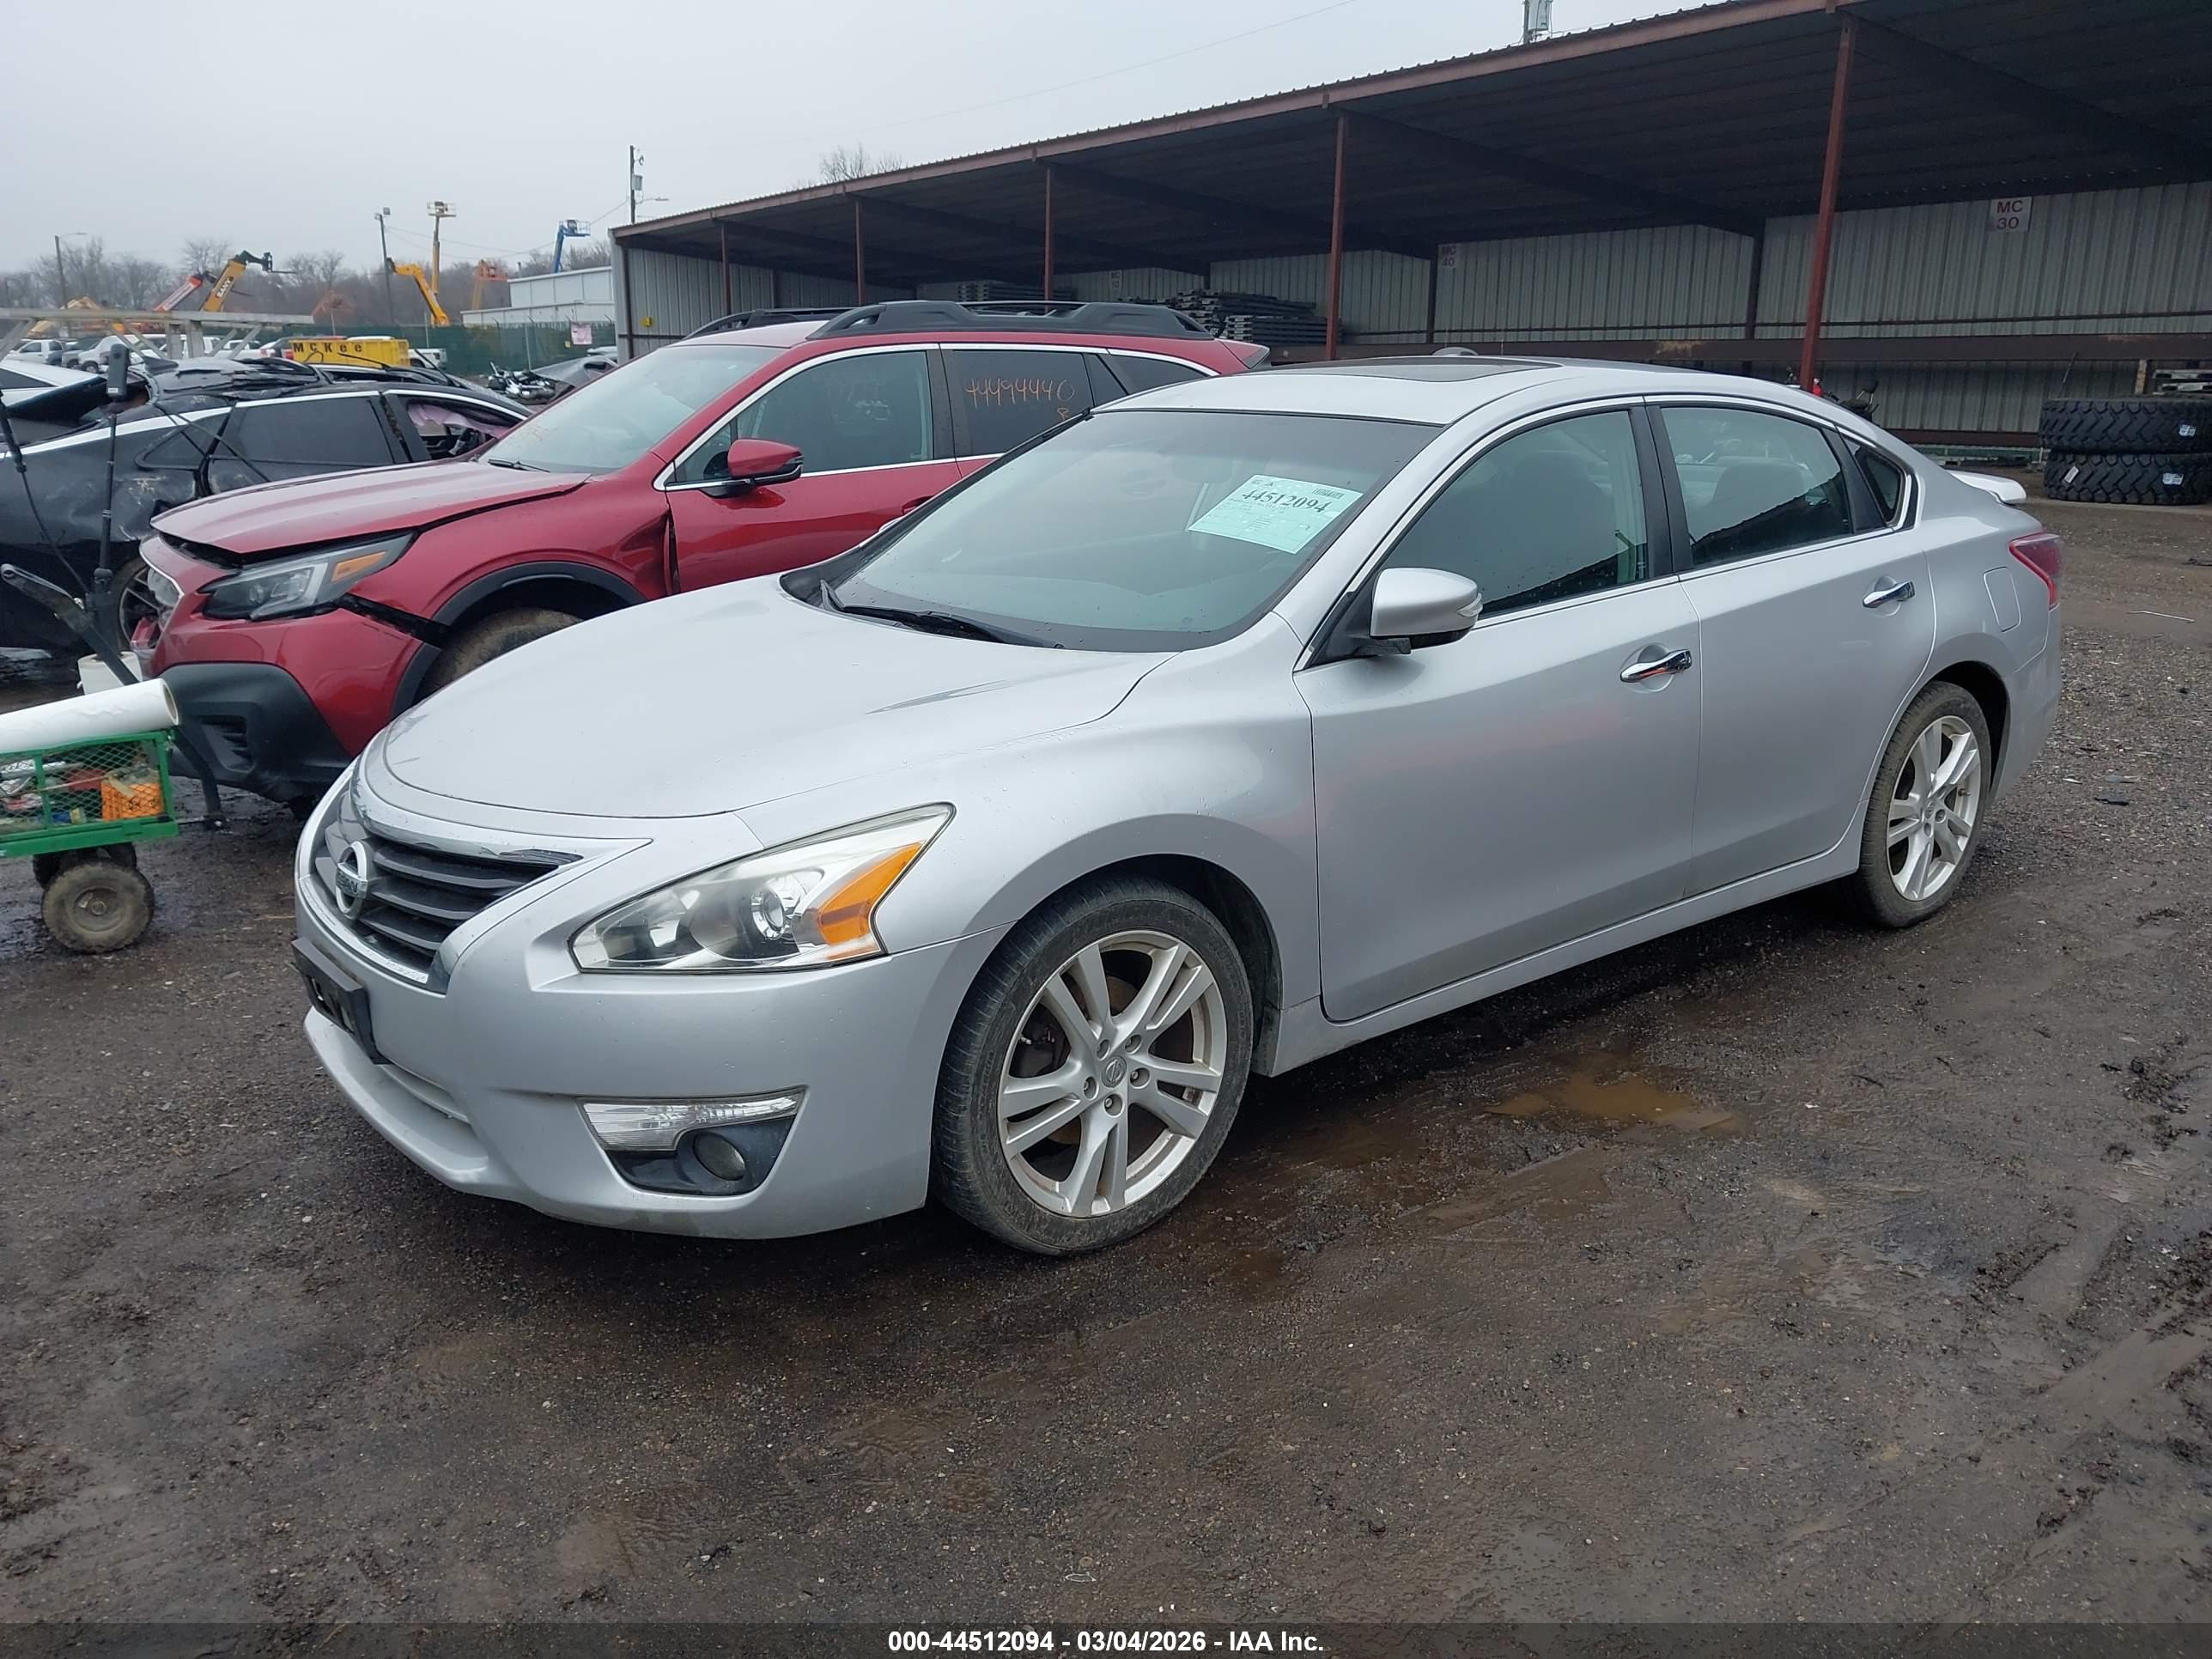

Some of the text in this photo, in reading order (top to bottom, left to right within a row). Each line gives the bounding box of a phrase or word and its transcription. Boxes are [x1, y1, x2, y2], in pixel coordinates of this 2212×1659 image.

[1996, 199, 2023, 213] MC
[1996, 216, 2020, 230] 30
[1242, 489, 1333, 513] 44512094
